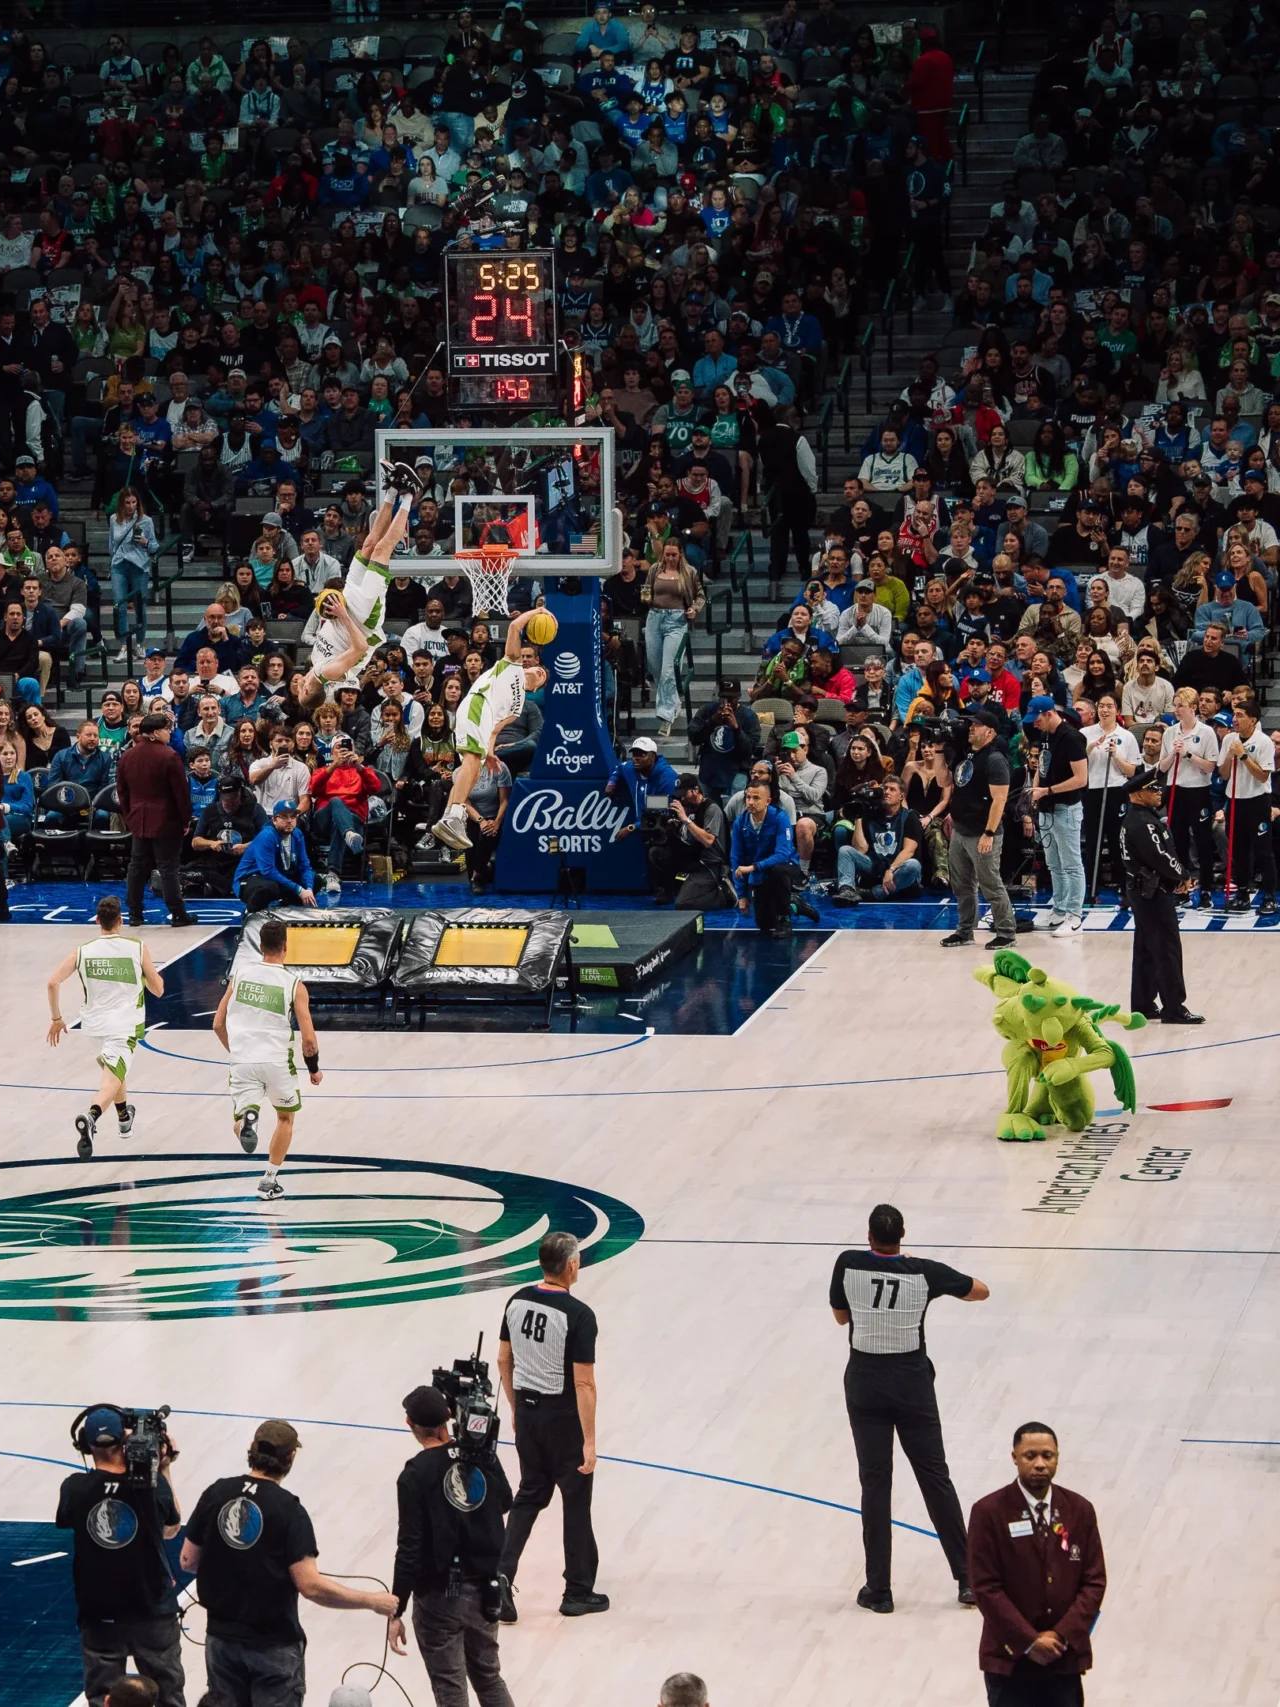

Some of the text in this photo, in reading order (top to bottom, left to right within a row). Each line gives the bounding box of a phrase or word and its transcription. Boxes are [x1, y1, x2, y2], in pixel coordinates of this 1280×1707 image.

[479, 263, 540, 291] 5:25
[471, 295, 532, 342] 24
[480, 353, 550, 367] TISSOT
[497, 379, 530, 400] 1:52
[668, 427, 689, 441] 70
[551, 682, 584, 695] AT&T
[546, 746, 595, 774] Kroger
[511, 788, 630, 844] Bally
[537, 834, 602, 853] SORTS
[1146, 822, 1183, 876] POLICE
[87, 967, 129, 976] SLOVENIA
[91, 959, 113, 969] FEEL
[585, 968, 601, 976] FEEL
[238, 991, 279, 1005] SLOVENIA
[244, 983, 265, 995] FEEL
[1119, 1145, 1194, 1182] Center
[1021, 1163, 1108, 1215] American
[870, 1278, 901, 1310] 77
[520, 1308, 548, 1344] 48
[104, 1481, 120, 1495] 77
[241, 1481, 258, 1496] 74
